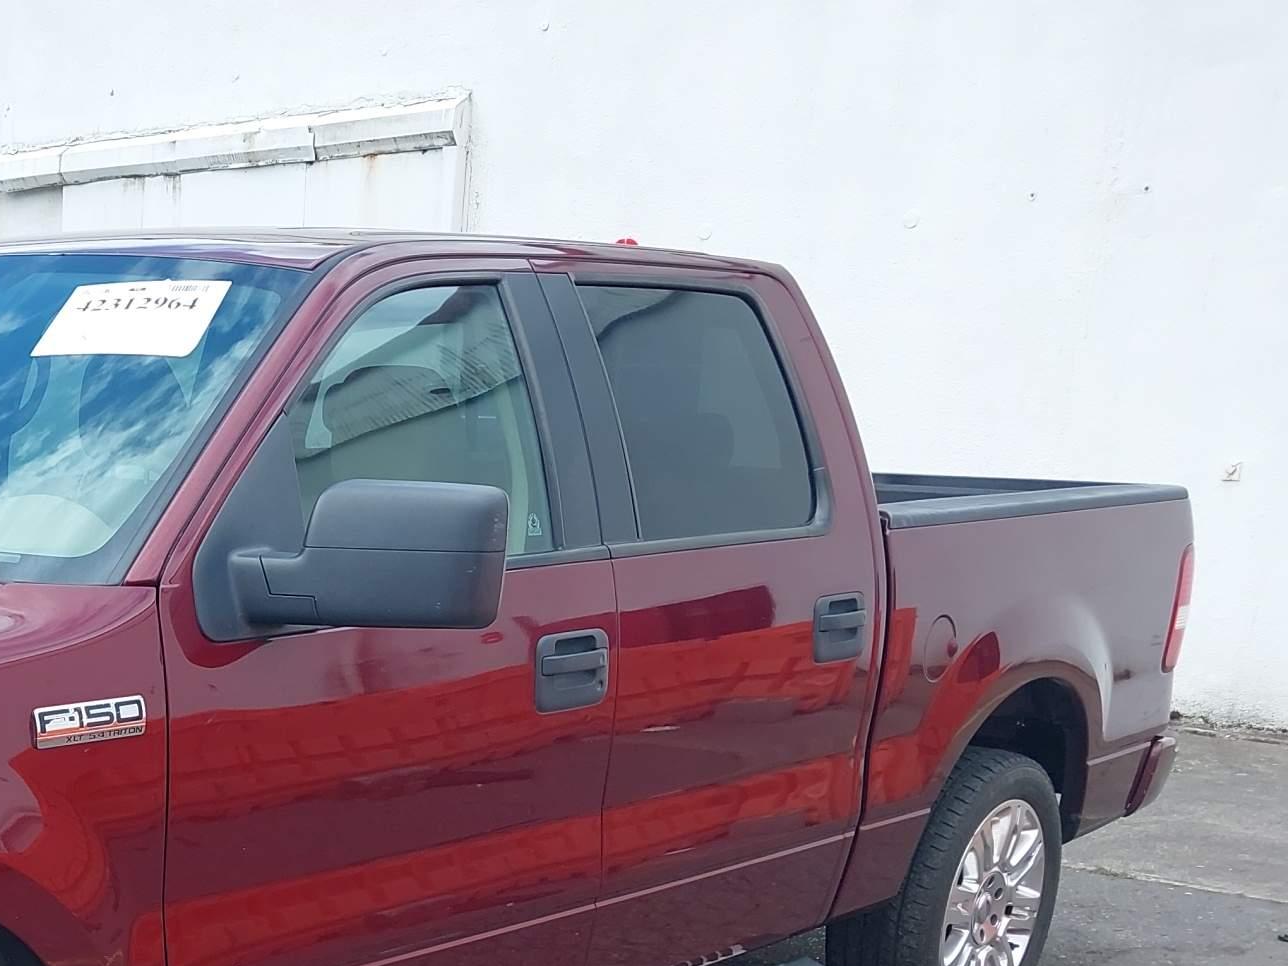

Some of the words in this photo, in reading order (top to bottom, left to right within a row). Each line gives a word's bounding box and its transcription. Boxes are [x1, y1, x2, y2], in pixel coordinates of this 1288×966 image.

[75, 296, 200, 313] 42312964
[65, 735, 84, 743] XLT
[106, 725, 143, 738] TRITON
